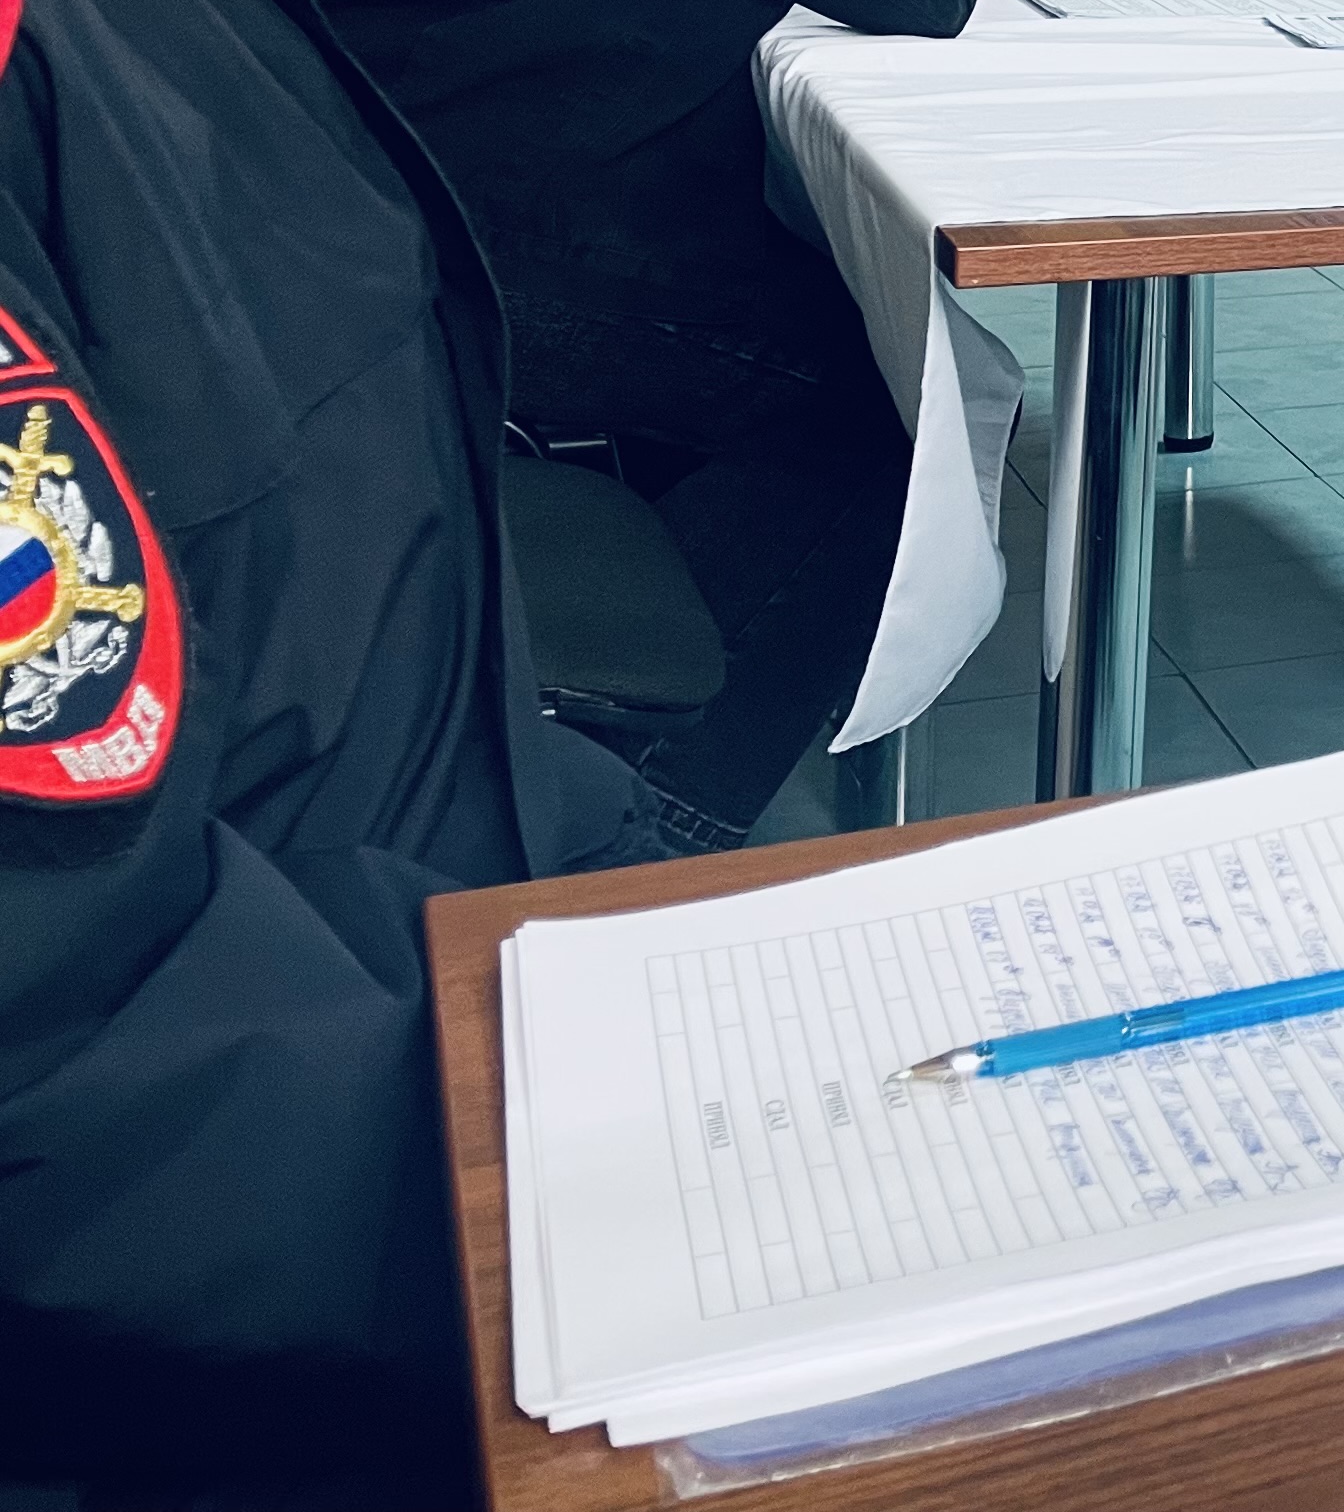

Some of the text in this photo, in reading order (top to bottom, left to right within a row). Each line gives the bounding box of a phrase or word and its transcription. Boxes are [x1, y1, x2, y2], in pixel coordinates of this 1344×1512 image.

[704, 1100, 732, 1150] ПРИНЯЛ
[765, 1098, 790, 1132] СДАЛ
[823, 1080, 852, 1128] ПРИНЯЛ
